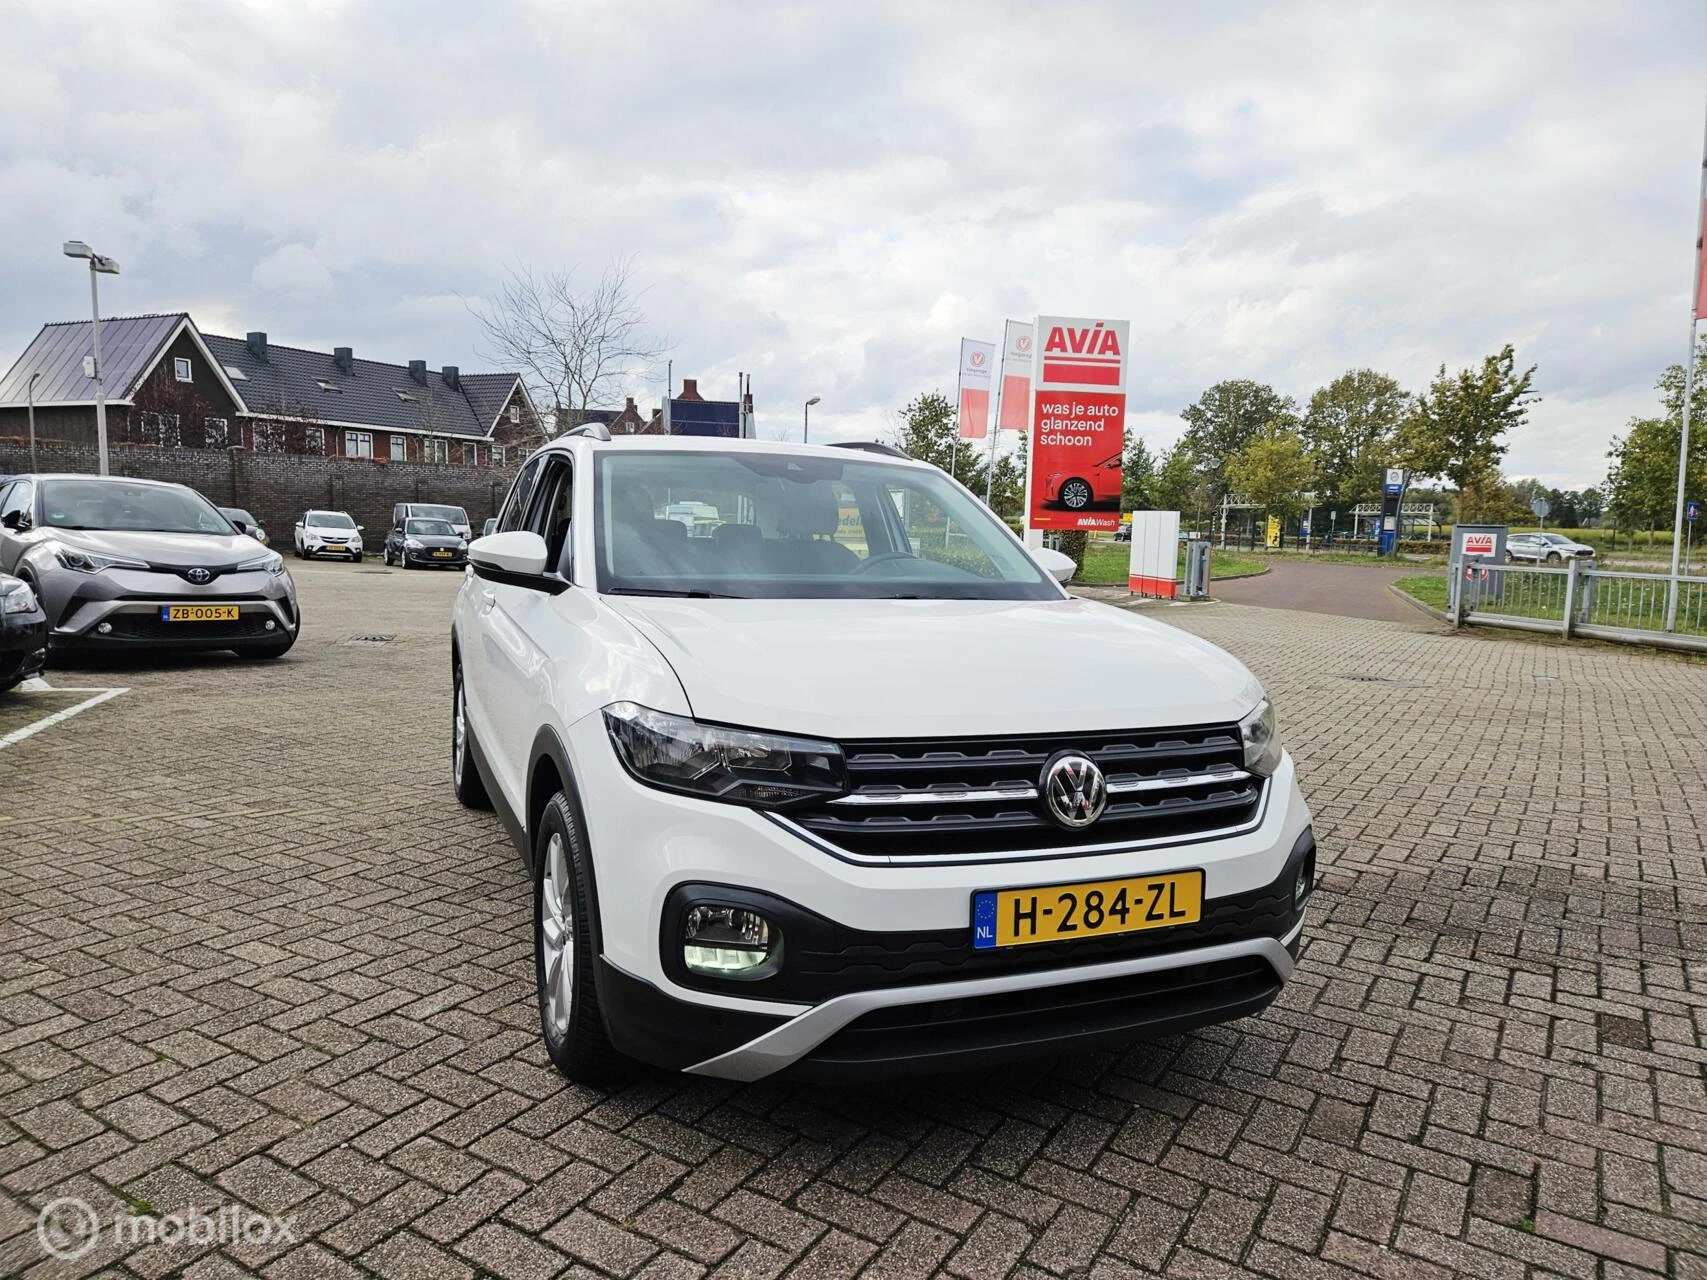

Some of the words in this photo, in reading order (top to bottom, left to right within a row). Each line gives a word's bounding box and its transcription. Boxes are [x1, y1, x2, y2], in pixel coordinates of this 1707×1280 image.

[1044, 322, 1121, 356] AVIA
[1042, 403, 1070, 415] was
[1070, 402, 1085, 418] je
[1087, 404, 1119, 417] auto
[1041, 416, 1105, 432] glanzend
[1040, 431, 1092, 446] schoon
[1466, 535, 1493, 545] AVIA
[172, 607, 235, 619] ZB-005-K
[976, 925, 993, 940] NL
[1013, 881, 1187, 937] H-284-ZL
